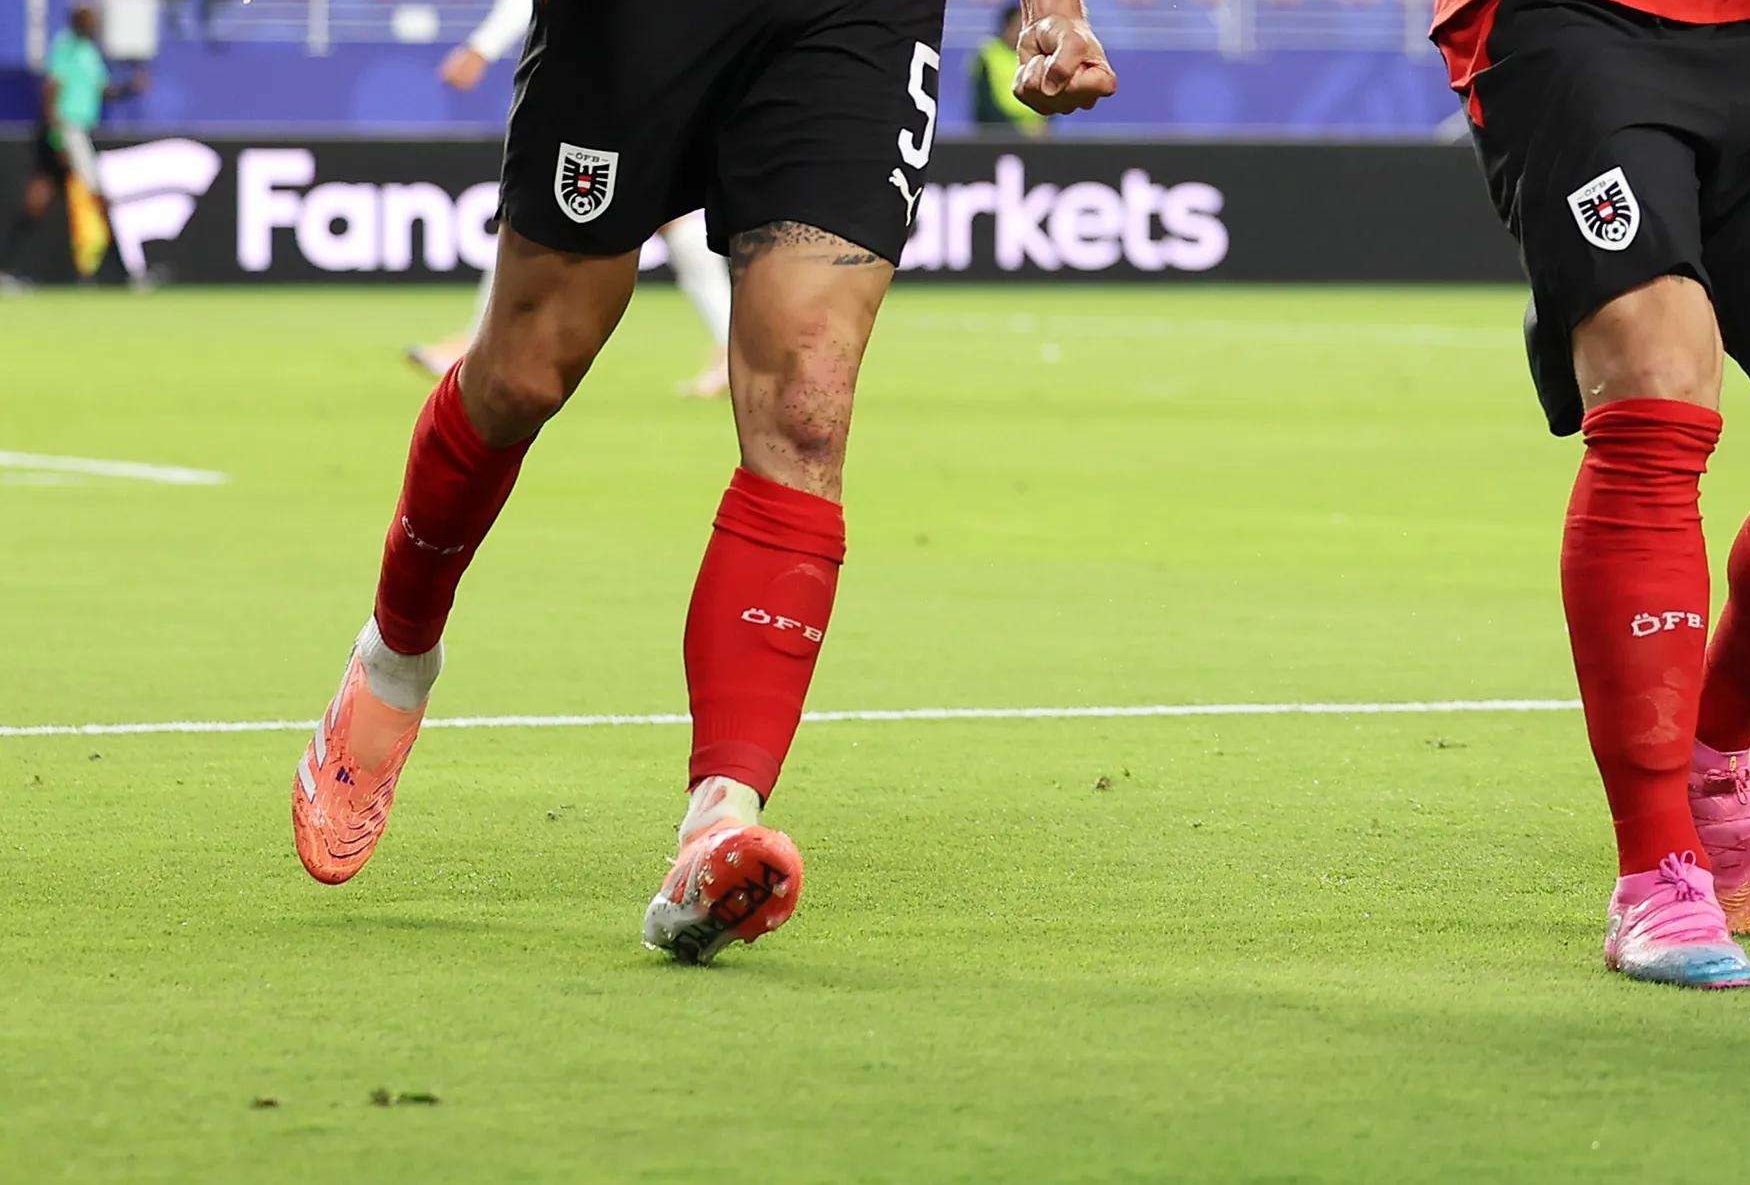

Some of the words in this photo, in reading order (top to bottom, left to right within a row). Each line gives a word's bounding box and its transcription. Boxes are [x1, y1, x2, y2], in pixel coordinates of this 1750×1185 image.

[898, 41, 940, 170] 5
[741, 607, 822, 643] ÖFB
[1631, 612, 1704, 637] ÖFB
